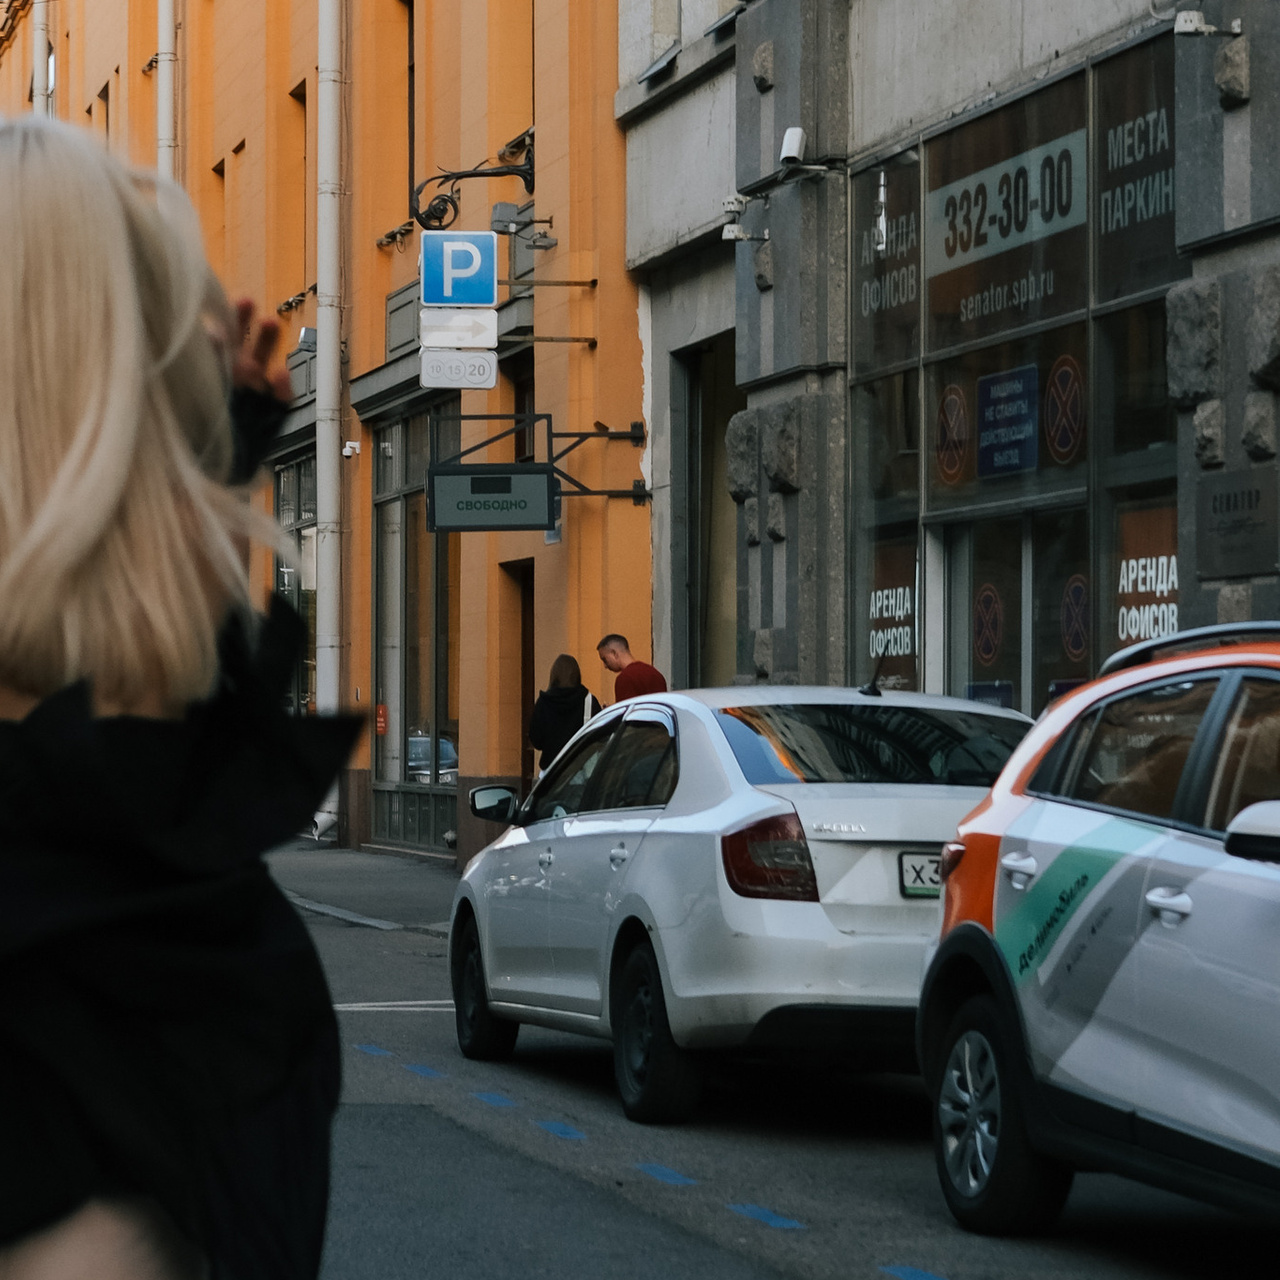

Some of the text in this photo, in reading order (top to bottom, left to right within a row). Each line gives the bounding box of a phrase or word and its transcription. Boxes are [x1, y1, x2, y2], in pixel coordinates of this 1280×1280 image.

[1108, 107, 1169, 171] МЕСТА
[944, 148, 1073, 259] 332-30-00
[861, 211, 917, 267] АРНДА
[861, 263, 917, 318] ОФИСОВ
[960, 269, 1054, 322] senator.spb.ru
[430, 364, 486, 376] 10 15 20
[456, 499, 527, 512] СВОБОДНО
[1119, 555, 1179, 598] АРЕНДА
[869, 586, 911, 621] АРЕНДА
[1119, 603, 1179, 641] ОФИСОВ
[869, 625, 911, 659] ОФИСОВ
